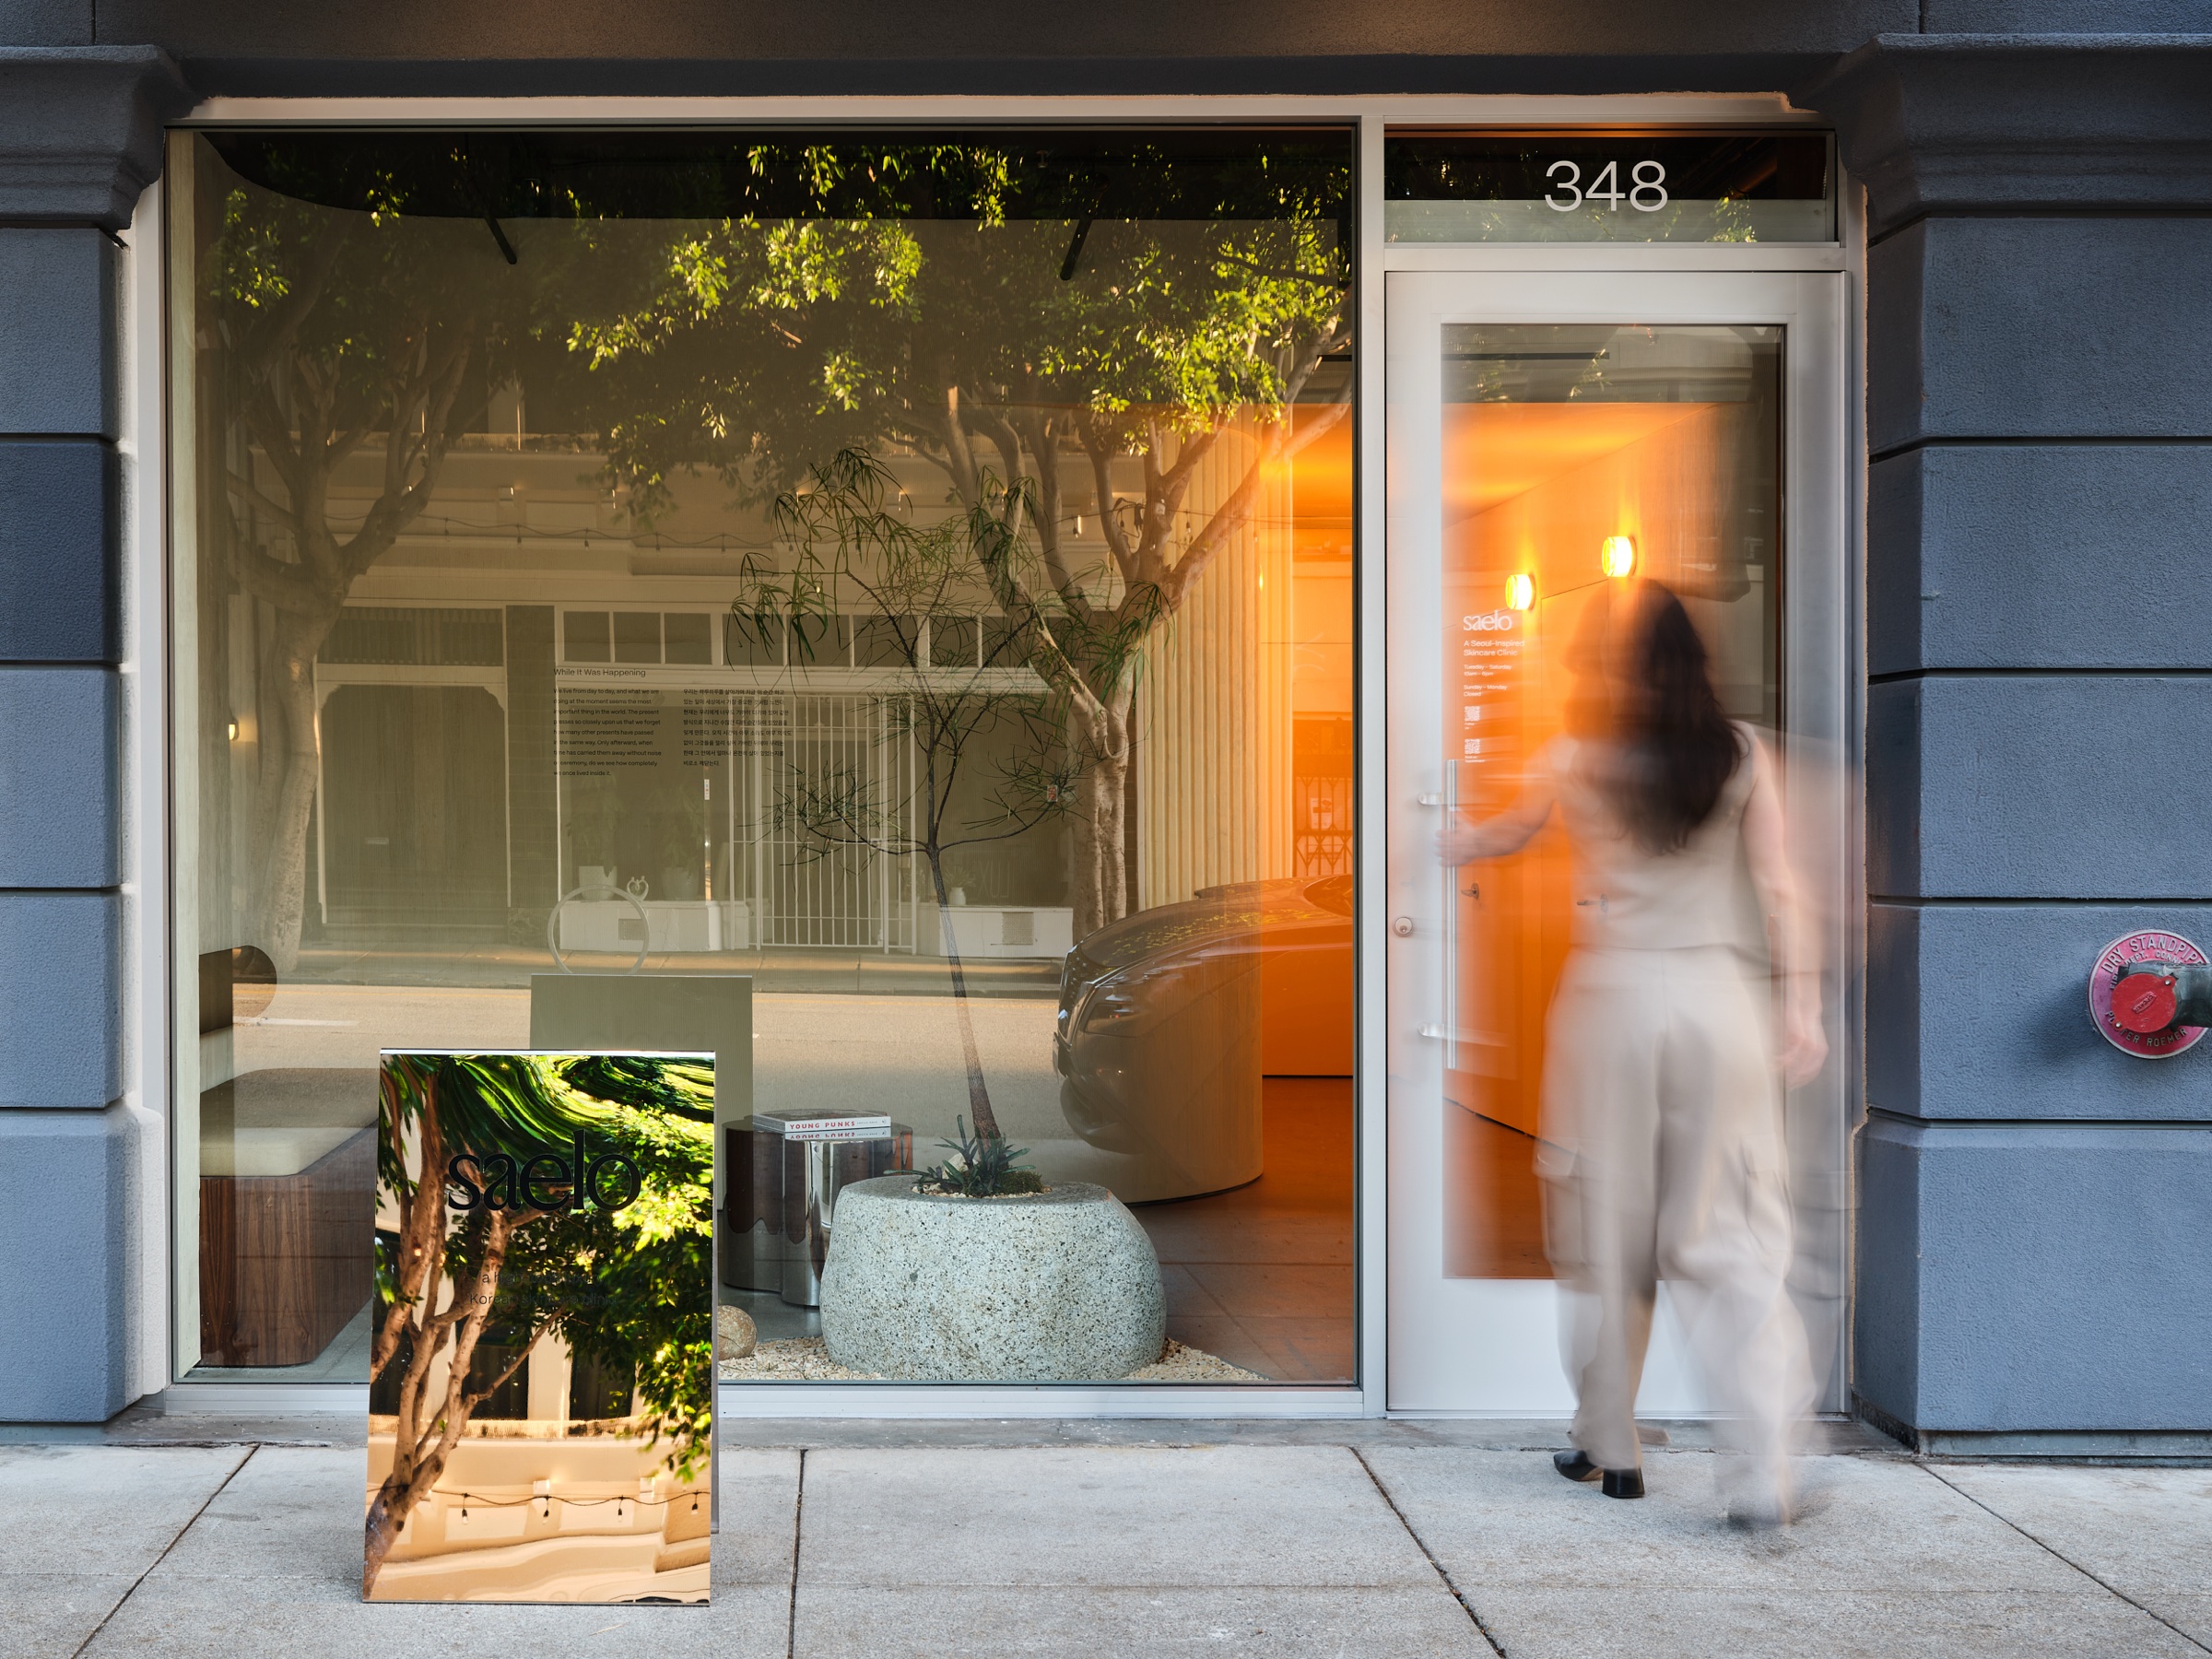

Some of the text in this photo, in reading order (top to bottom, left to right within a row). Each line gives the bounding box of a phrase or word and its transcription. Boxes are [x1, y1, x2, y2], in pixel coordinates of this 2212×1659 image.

[1545, 160, 1668, 212] 348
[1464, 610, 1512, 630] saelo
[603, 669, 646, 677] Happening
[2101, 947, 2125, 974] DRY
[2147, 1028, 2188, 1047] ROEMER
[448, 1130, 641, 1211] saelo
[482, 1274, 490, 1283] a
[470, 1294, 518, 1305] Korean
